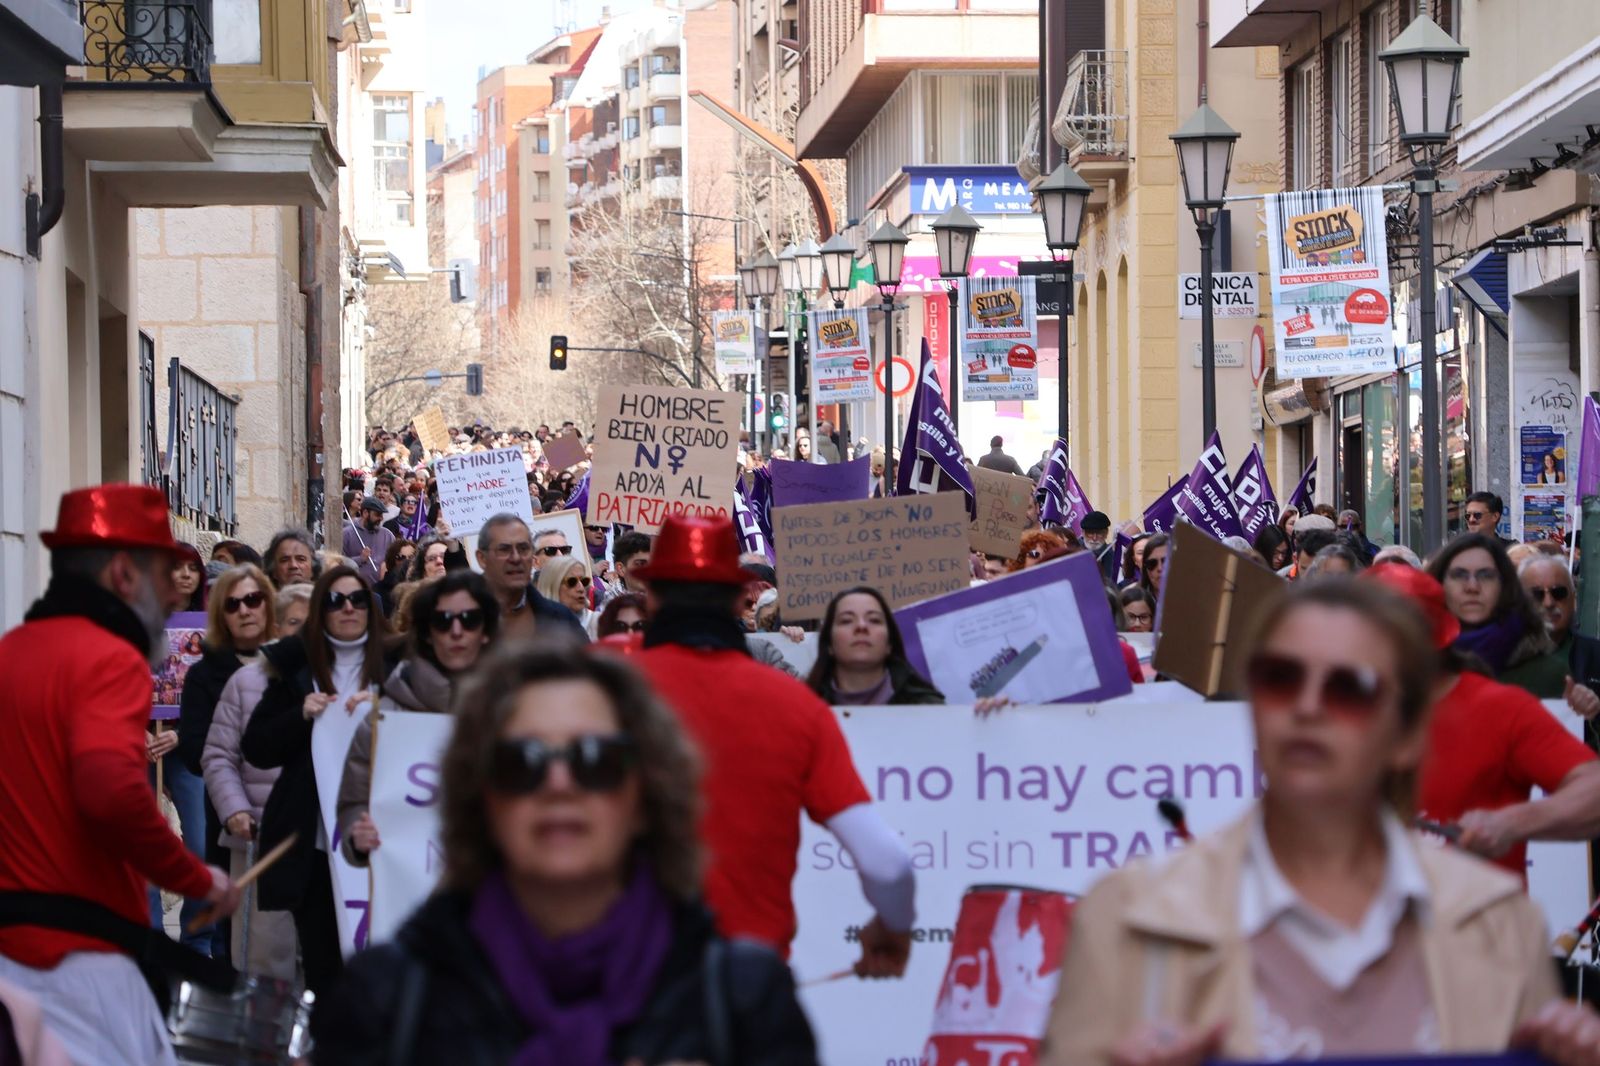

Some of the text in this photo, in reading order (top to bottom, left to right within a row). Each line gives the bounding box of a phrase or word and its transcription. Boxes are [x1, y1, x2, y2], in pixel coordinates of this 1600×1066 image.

[984, 182, 1033, 196] MEA
[1294, 210, 1352, 242] STOCK
[1184, 276, 1254, 290] CLNICA
[976, 291, 1013, 312] STOCK
[822, 320, 852, 336] STOCK
[1284, 355, 1296, 363] TU
[1297, 352, 1344, 362] COMERCIO
[620, 394, 725, 424] HOMBRE
[608, 418, 728, 449] BIEN CRIADO
[919, 420, 948, 448] stilla
[436, 450, 523, 474] FEMINISTA
[466, 478, 507, 492] MADRE
[615, 471, 711, 500] APOYA AL
[461, 505, 475, 514] ver
[1202, 483, 1232, 520] mujer
[451, 518, 474, 528] bien
[832, 510, 850, 525] DE
[1204, 514, 1213, 522] y
[1210, 520, 1226, 540] Leó
[786, 532, 840, 550] TODOS
[846, 528, 882, 544] LOS
[890, 522, 963, 540] HOMBRES
[782, 554, 814, 568] SON
[877, 564, 897, 578] DE
[902, 560, 924, 576] NO
[927, 558, 962, 572] SER
[877, 764, 953, 801] no
[976, 752, 1087, 812] hay
[966, 831, 1034, 870] sin
